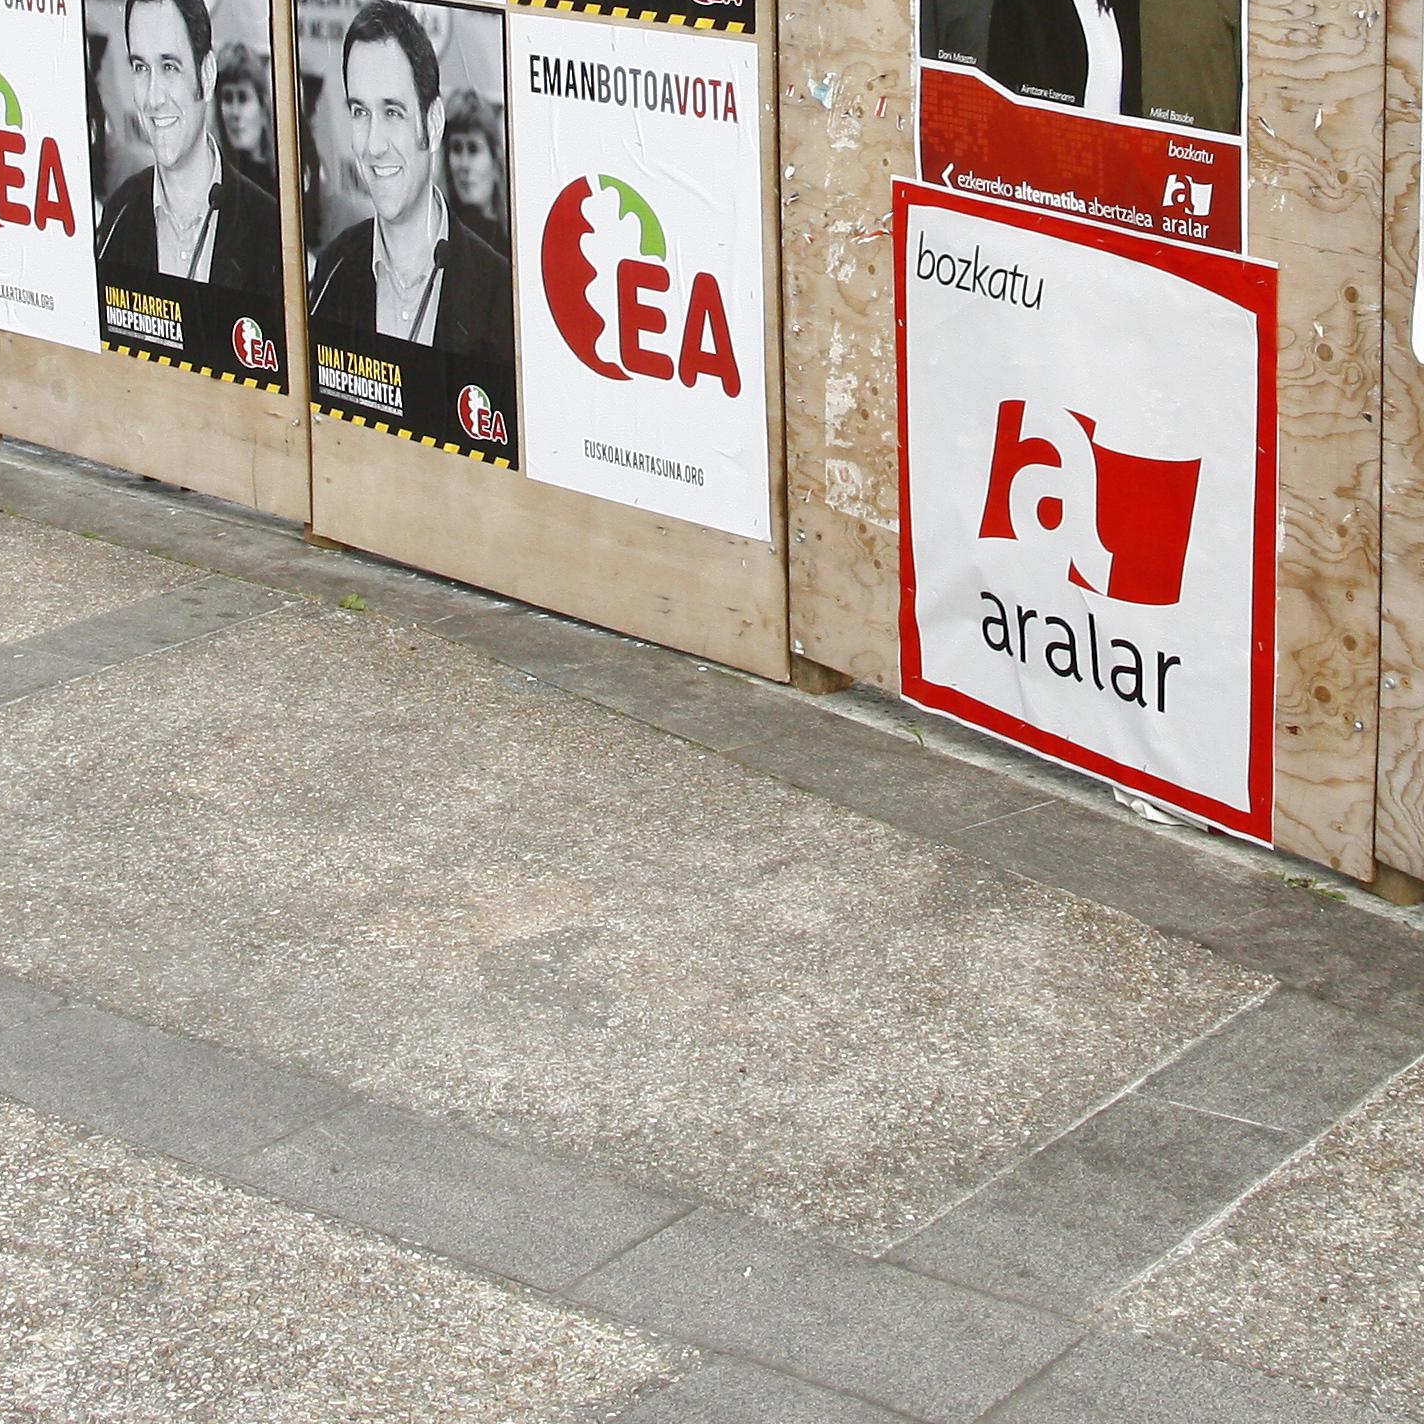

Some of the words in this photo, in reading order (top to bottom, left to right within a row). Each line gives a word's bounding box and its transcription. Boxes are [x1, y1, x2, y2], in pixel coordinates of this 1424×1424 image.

[1168, 141, 1214, 165] bozkatu
[957, 172, 1013, 197] ezkerreko
[1014, 182, 1086, 214] alternatiba
[1088, 198, 1153, 229] abertzalea
[1162, 216, 1210, 240] aralar
[917, 231, 1044, 311] bozkatu
[105, 285, 129, 311] UNAI
[132, 292, 183, 323] ZIARRETA
[106, 306, 184, 342] INDEPENDENTEA
[616, 258, 742, 399] EA
[251, 338, 279, 372] EA
[317, 344, 344, 371] UNAI
[347, 352, 403, 388] ZIARRETA
[318, 365, 404, 409] INDEPENDENTEA
[476, 408, 508, 445] EA
[584, 438, 705, 487] EUSKOALKARTASUNA.ORG
[980, 590, 1181, 713] aralar
